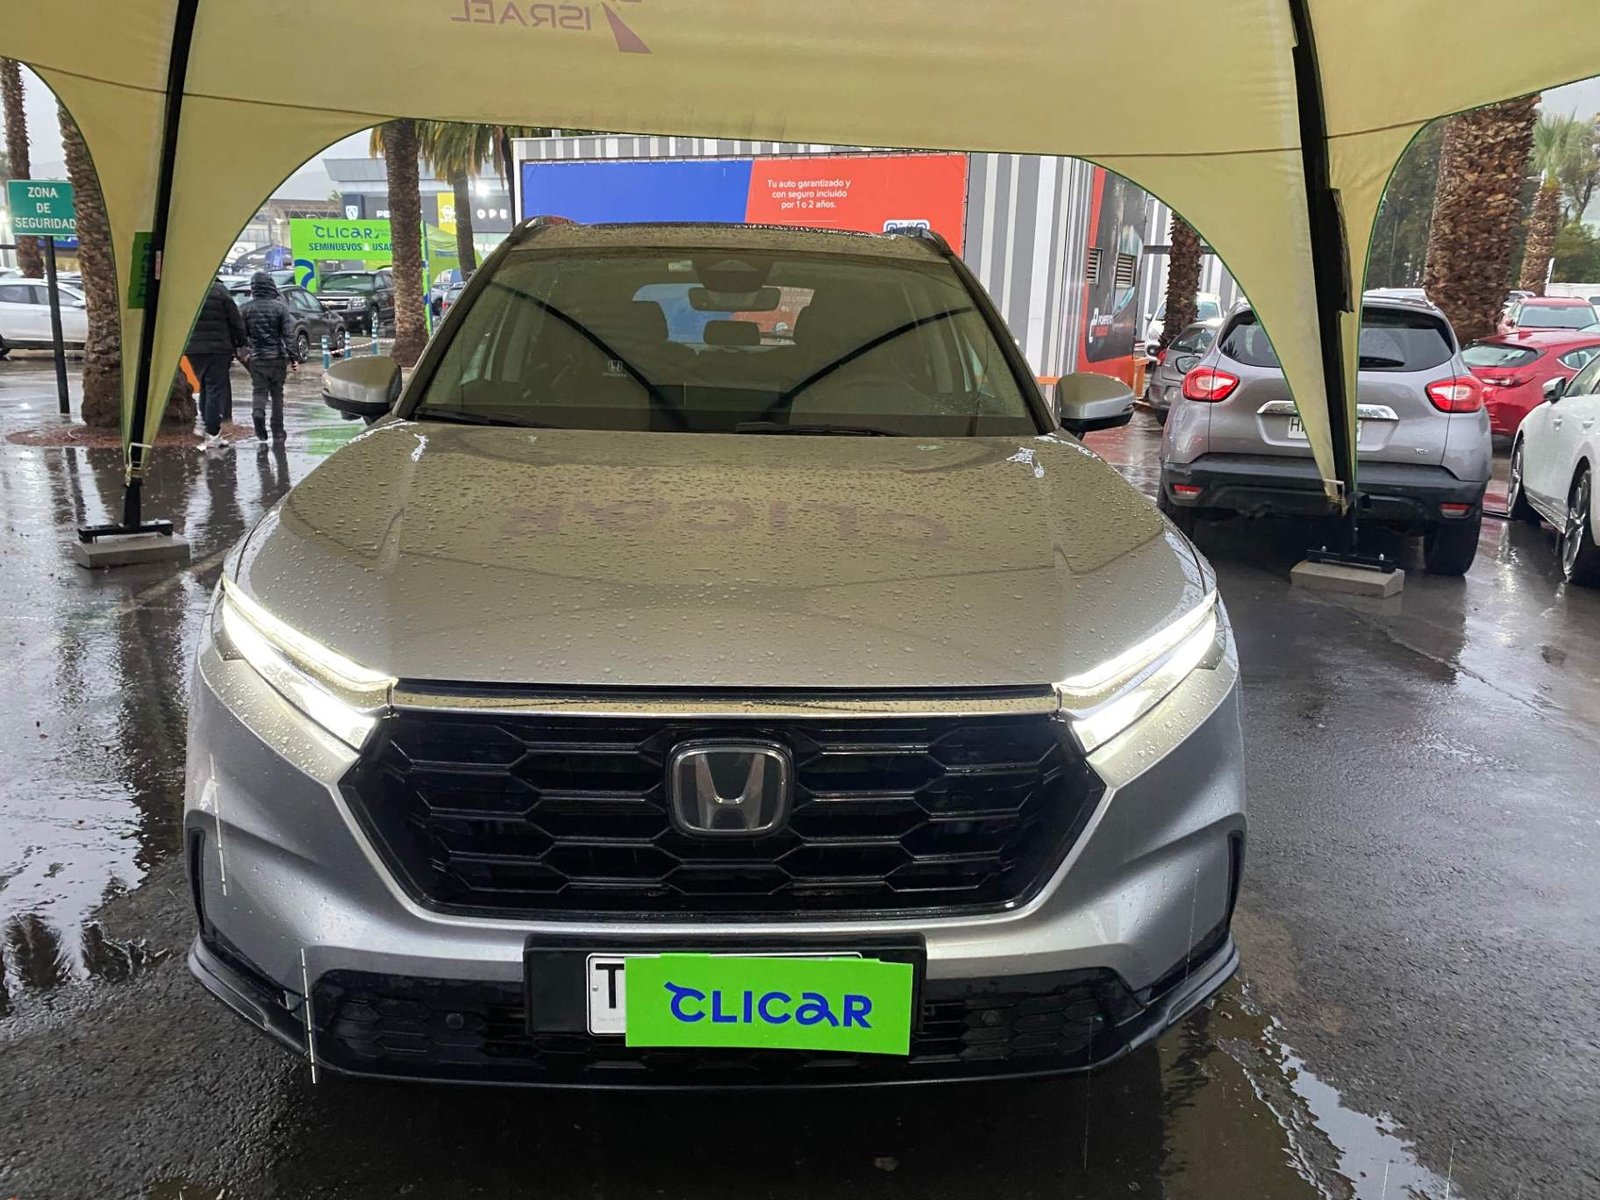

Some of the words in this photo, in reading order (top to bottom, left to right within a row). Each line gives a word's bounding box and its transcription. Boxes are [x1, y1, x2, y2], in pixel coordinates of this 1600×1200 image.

[767, 180, 777, 188] Tu
[797, 179, 844, 189] garantizado
[845, 180, 851, 189] y
[27, 186, 59, 199] ZONA
[788, 191, 815, 200] seguro
[816, 189, 847, 198] incluido
[36, 202, 52, 214] DE
[781, 202, 795, 210] por
[796, 201, 800, 209] 1
[808, 200, 814, 208] 2
[815, 200, 838, 209] años.
[14, 217, 77, 229] SEGURIDAD
[308, 242, 363, 251] SEMINUEVOS
